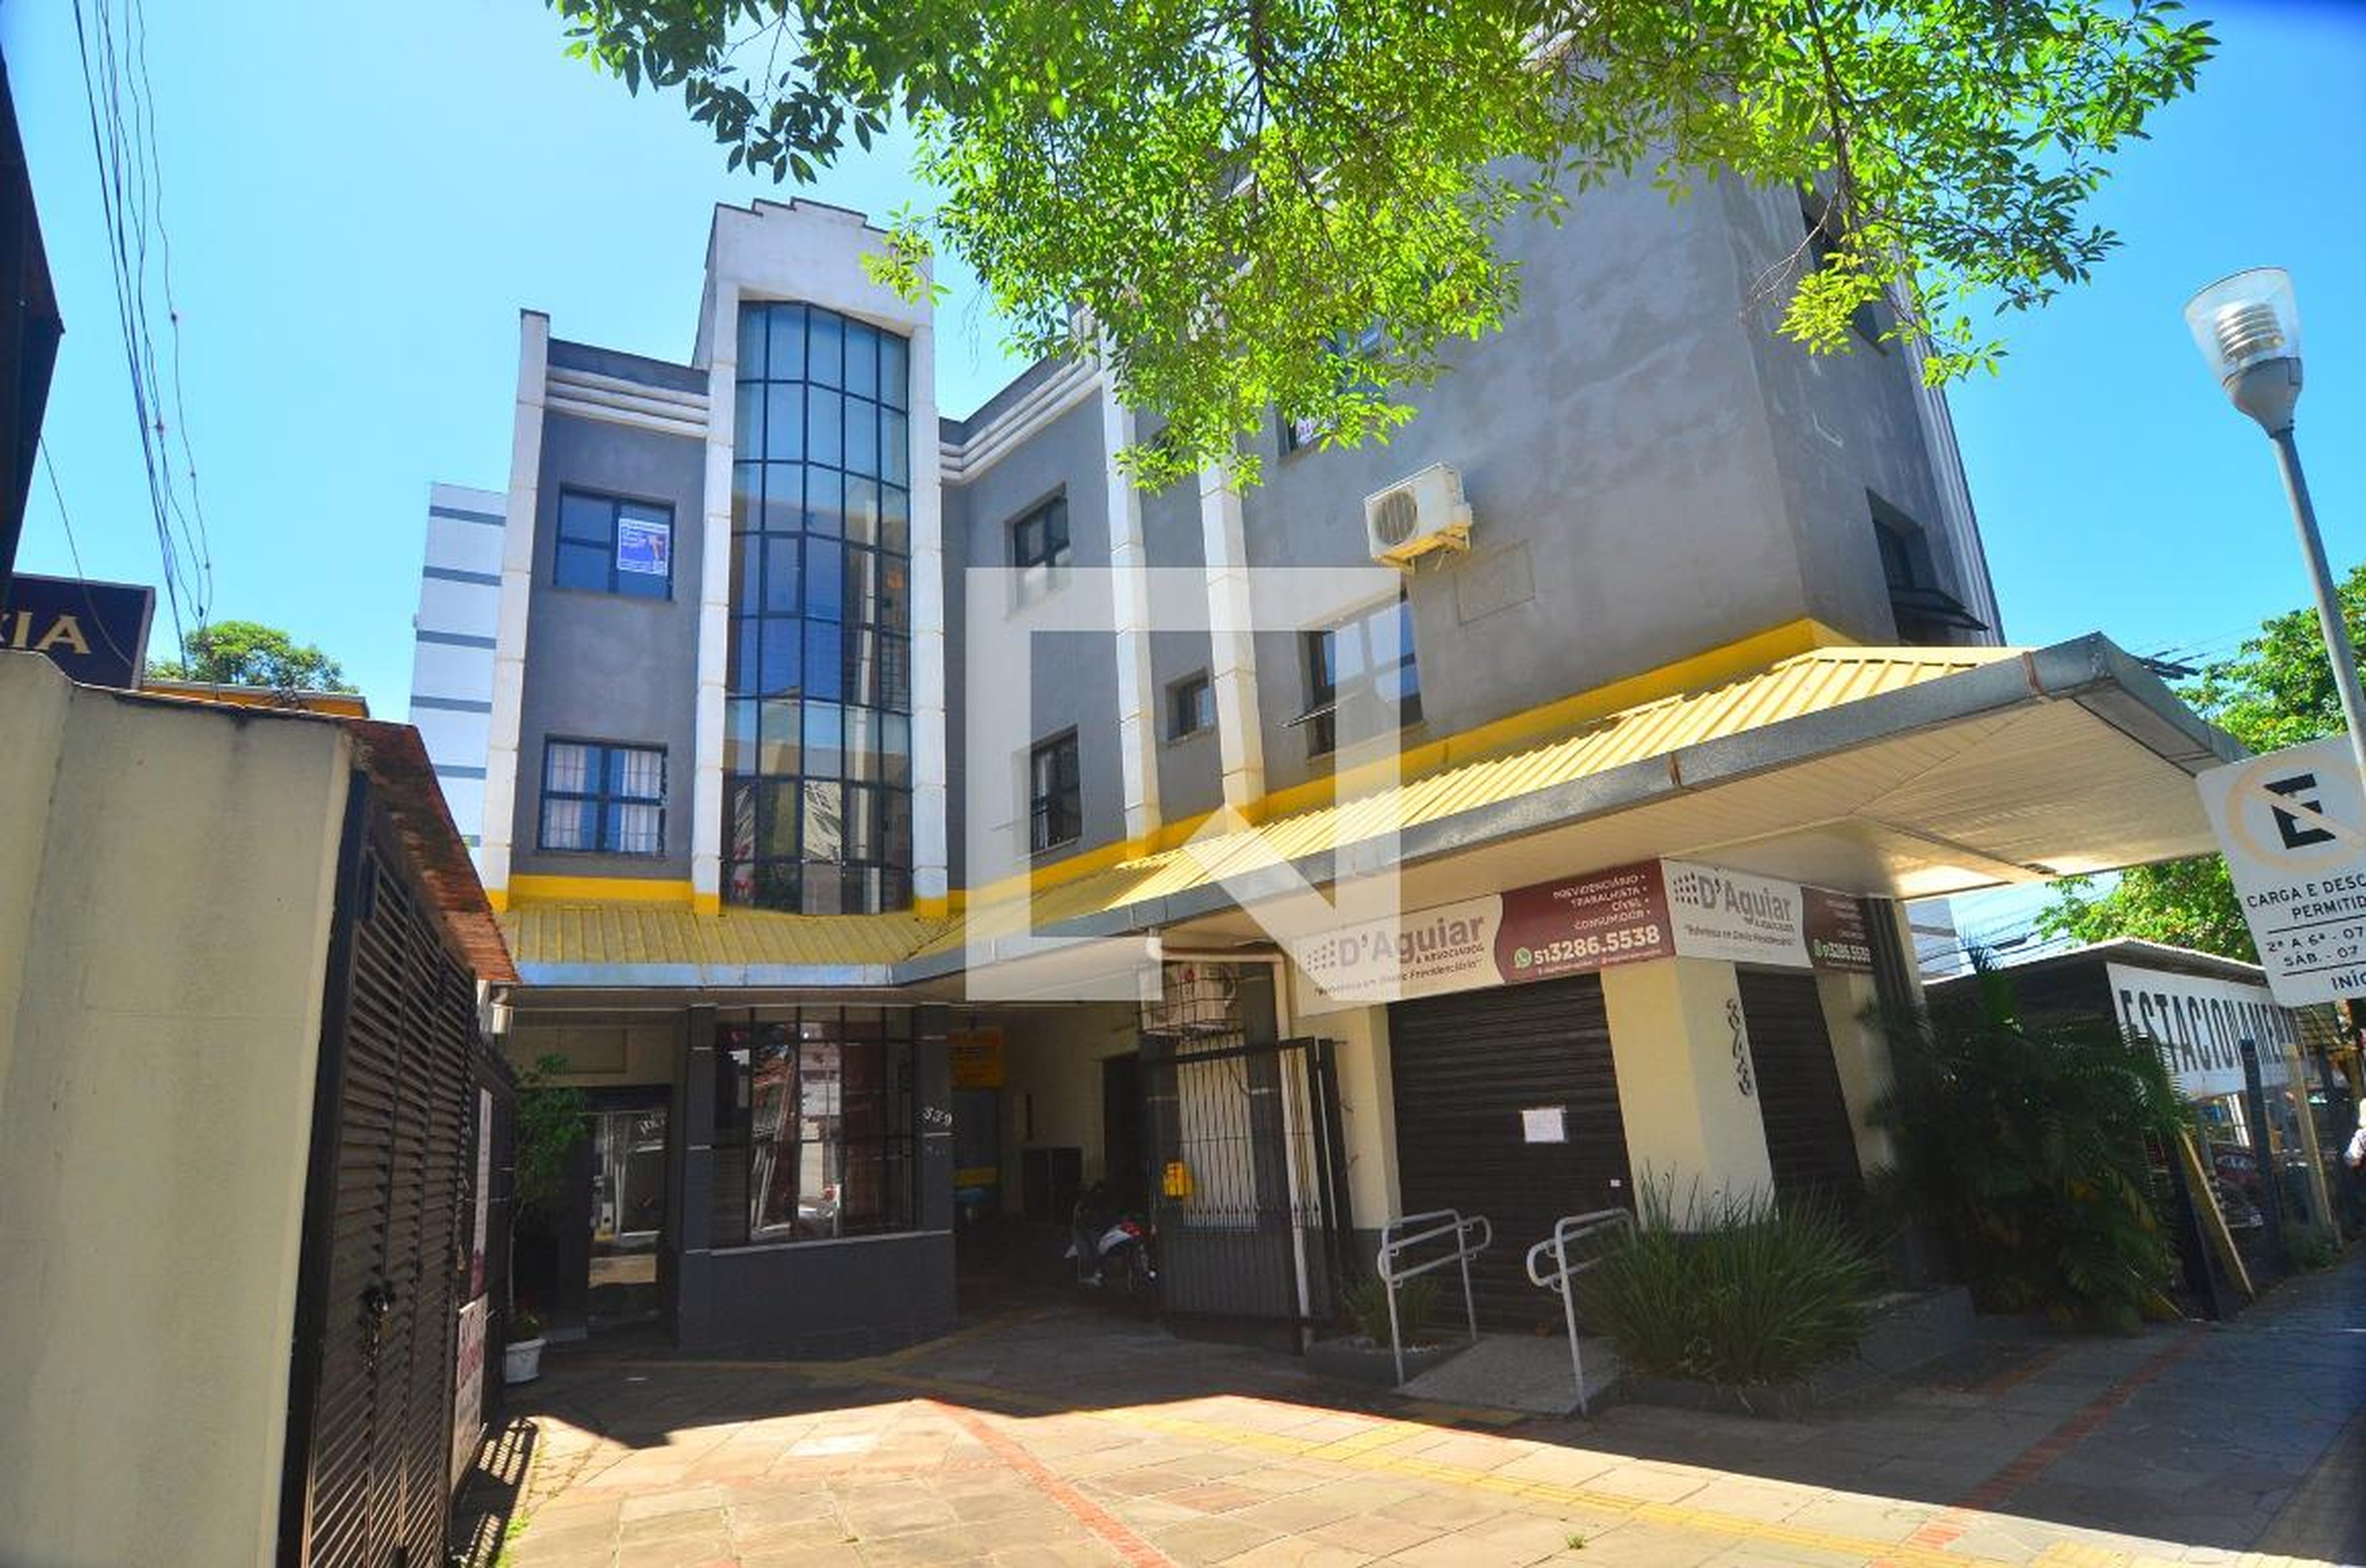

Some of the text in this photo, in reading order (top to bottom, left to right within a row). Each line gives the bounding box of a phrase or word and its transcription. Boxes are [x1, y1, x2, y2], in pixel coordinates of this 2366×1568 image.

[0, 611, 91, 654] IA
[1698, 874, 1791, 924] D'Aguiar
[2246, 874, 2366, 908] CARGA E DESC
[2291, 938, 2302, 949] A
[2343, 926, 2364, 940] 07
